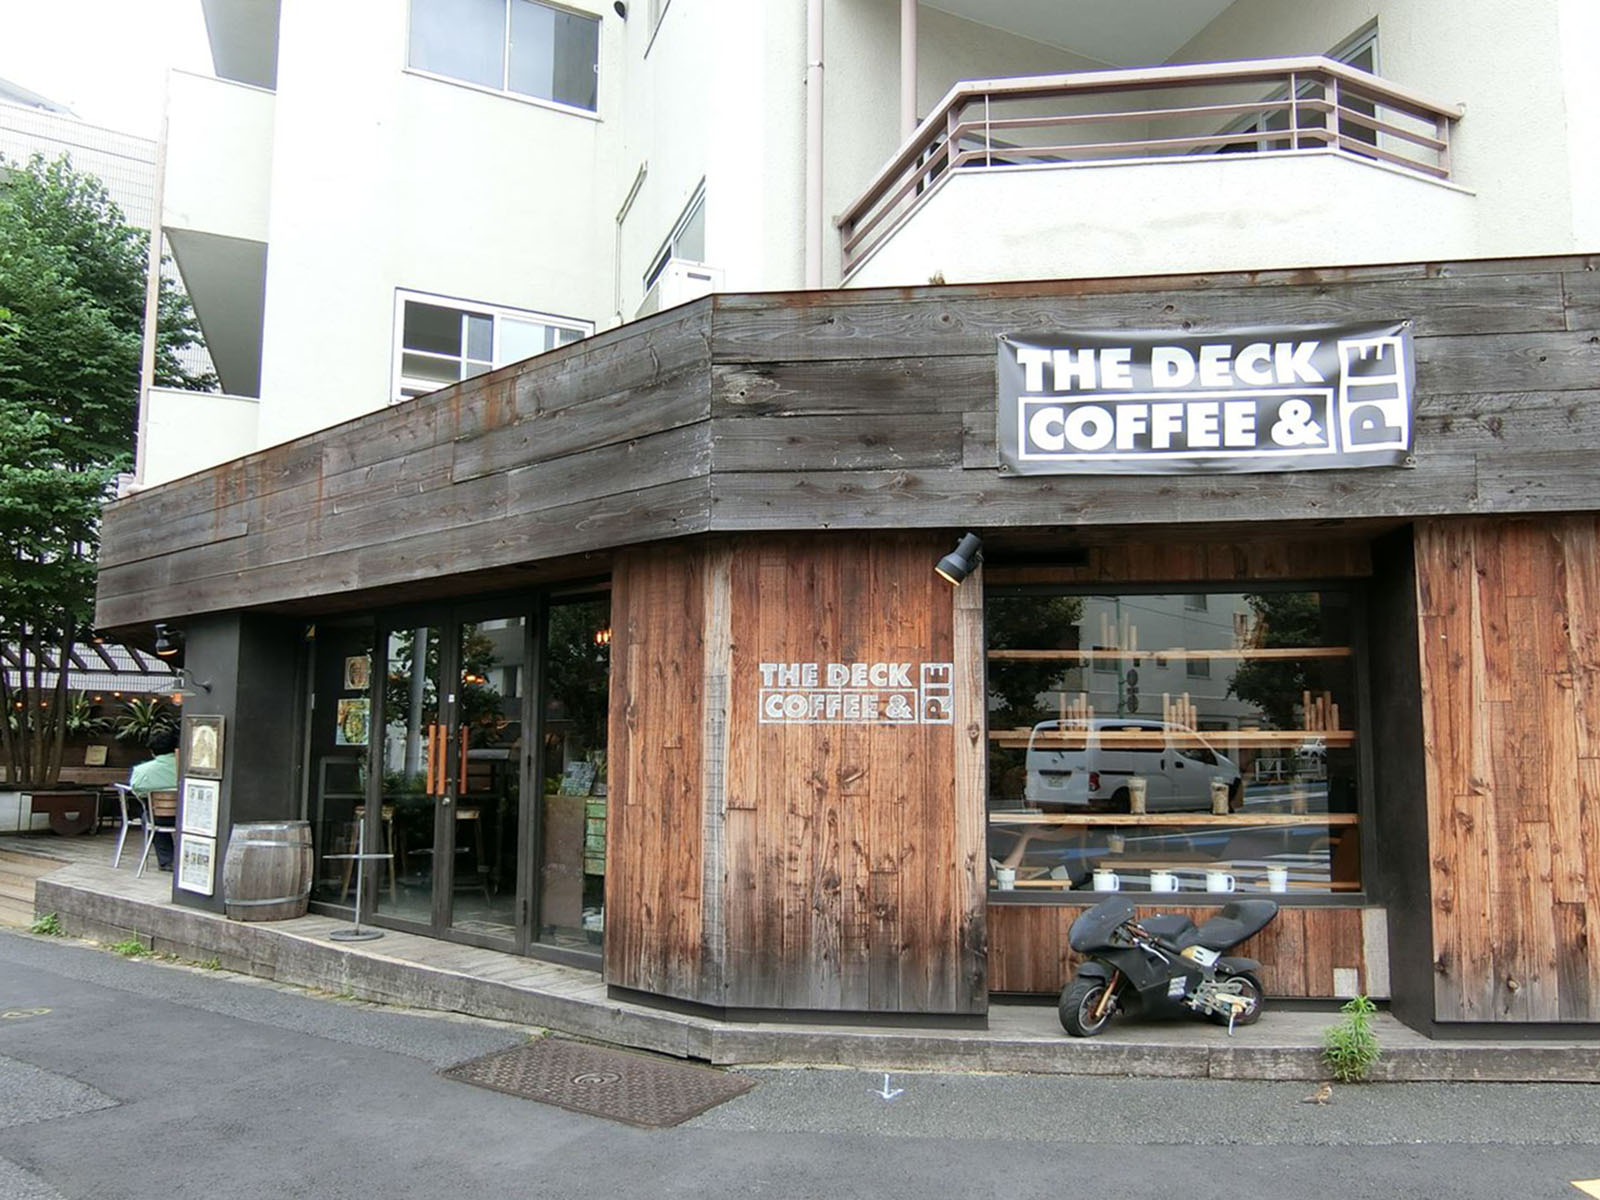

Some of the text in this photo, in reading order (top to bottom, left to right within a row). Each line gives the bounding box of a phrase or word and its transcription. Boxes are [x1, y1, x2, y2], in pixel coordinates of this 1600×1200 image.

[1017, 340, 1325, 392] THE DECK
[1347, 340, 1402, 444] PIE
[1030, 399, 1328, 451] COFFEE &
[759, 663, 912, 687] THE DECK
[925, 666, 950, 719] PIE
[765, 694, 913, 718] COFFEE &
